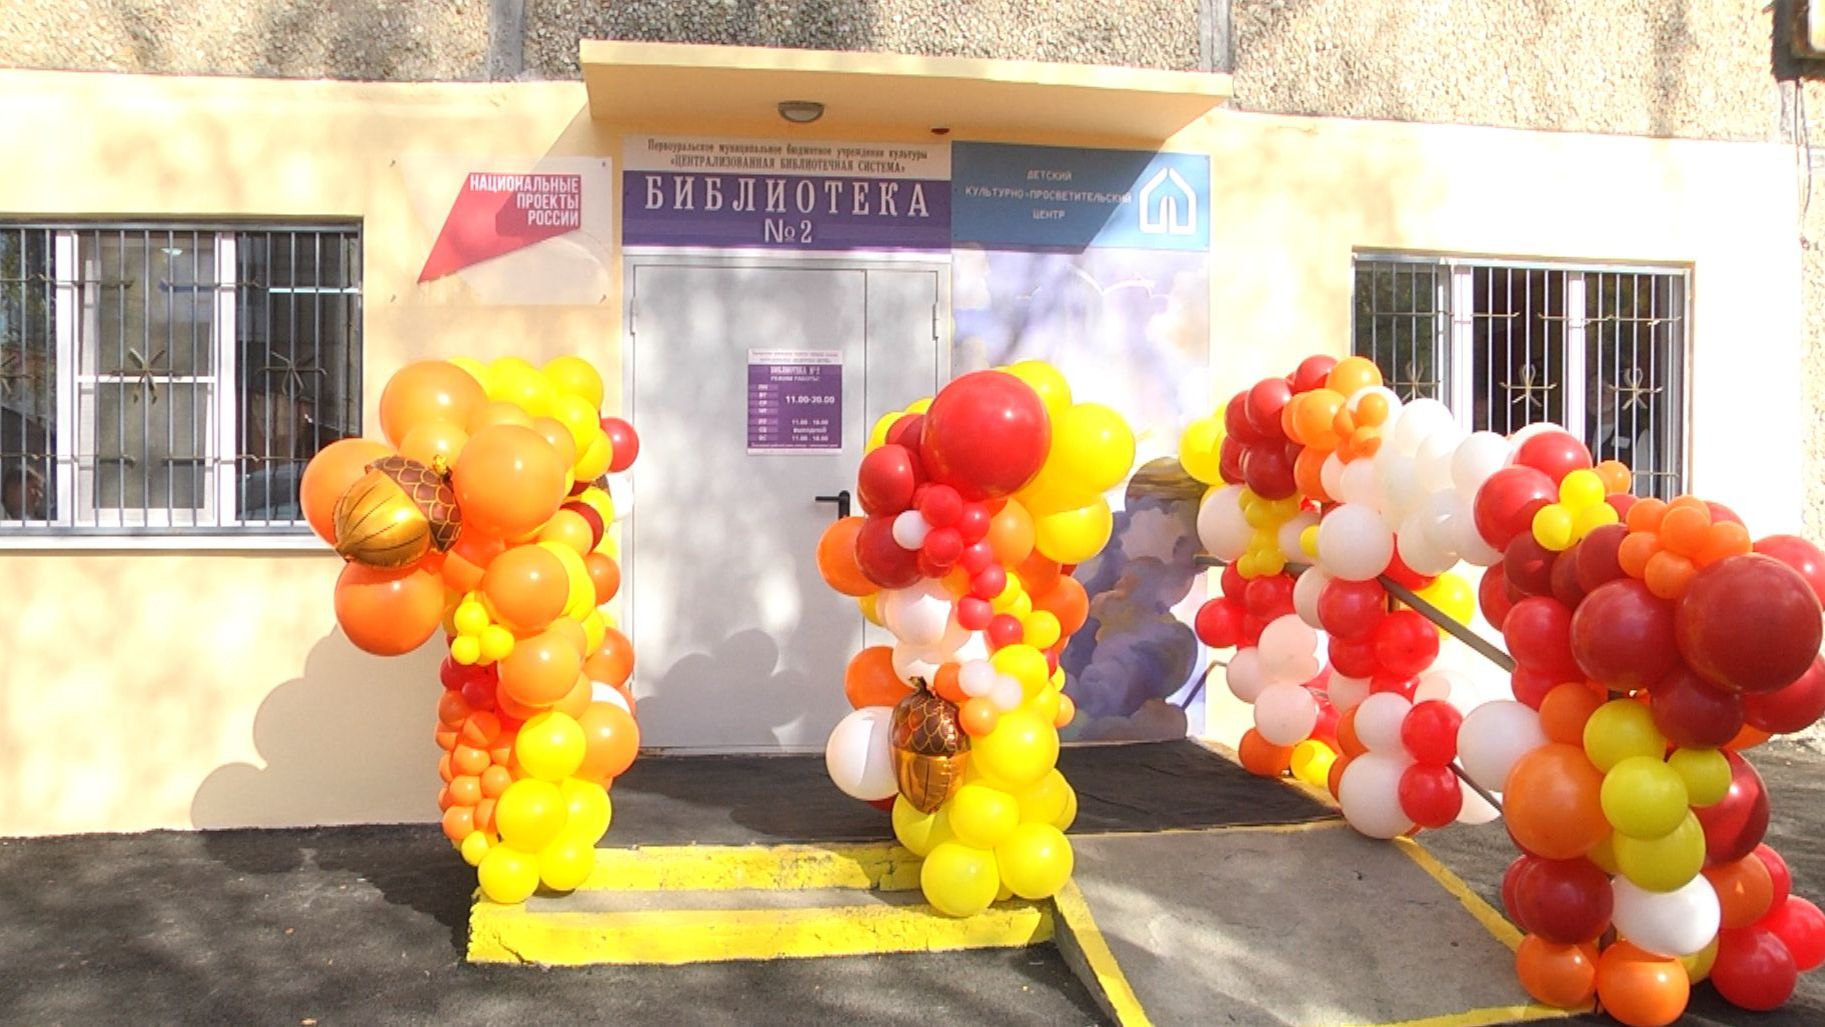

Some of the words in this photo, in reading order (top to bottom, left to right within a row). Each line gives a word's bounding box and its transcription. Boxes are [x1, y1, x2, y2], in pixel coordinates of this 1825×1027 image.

[647, 139, 714, 153] Первоуральское
[719, 144, 782, 155] муниципальное
[786, 144, 831, 157] бюджетное
[889, 150, 928, 161] культуры
[670, 154, 775, 169] «ЦЕНТРАЛИЗОВАННАЯ
[780, 158, 853, 172] БИБЛИОТЕЧНАЯ
[858, 161, 906, 174] СИСТЕМА»
[469, 174, 579, 193] НАЦИОНАЛЬНЫЕ
[1027, 170, 1073, 181] ДЕТСКИЙ
[516, 193, 579, 209] ПРОЕКТЫ
[645, 175, 929, 217] БИБЛИОТЕКА
[965, 187, 1132, 204] КУЛЬТУРНО-ПРОСВЕТИТЕЛЬСКИЙ
[527, 209, 579, 226] РОССИИ
[1032, 209, 1066, 220] ЦЕНТР
